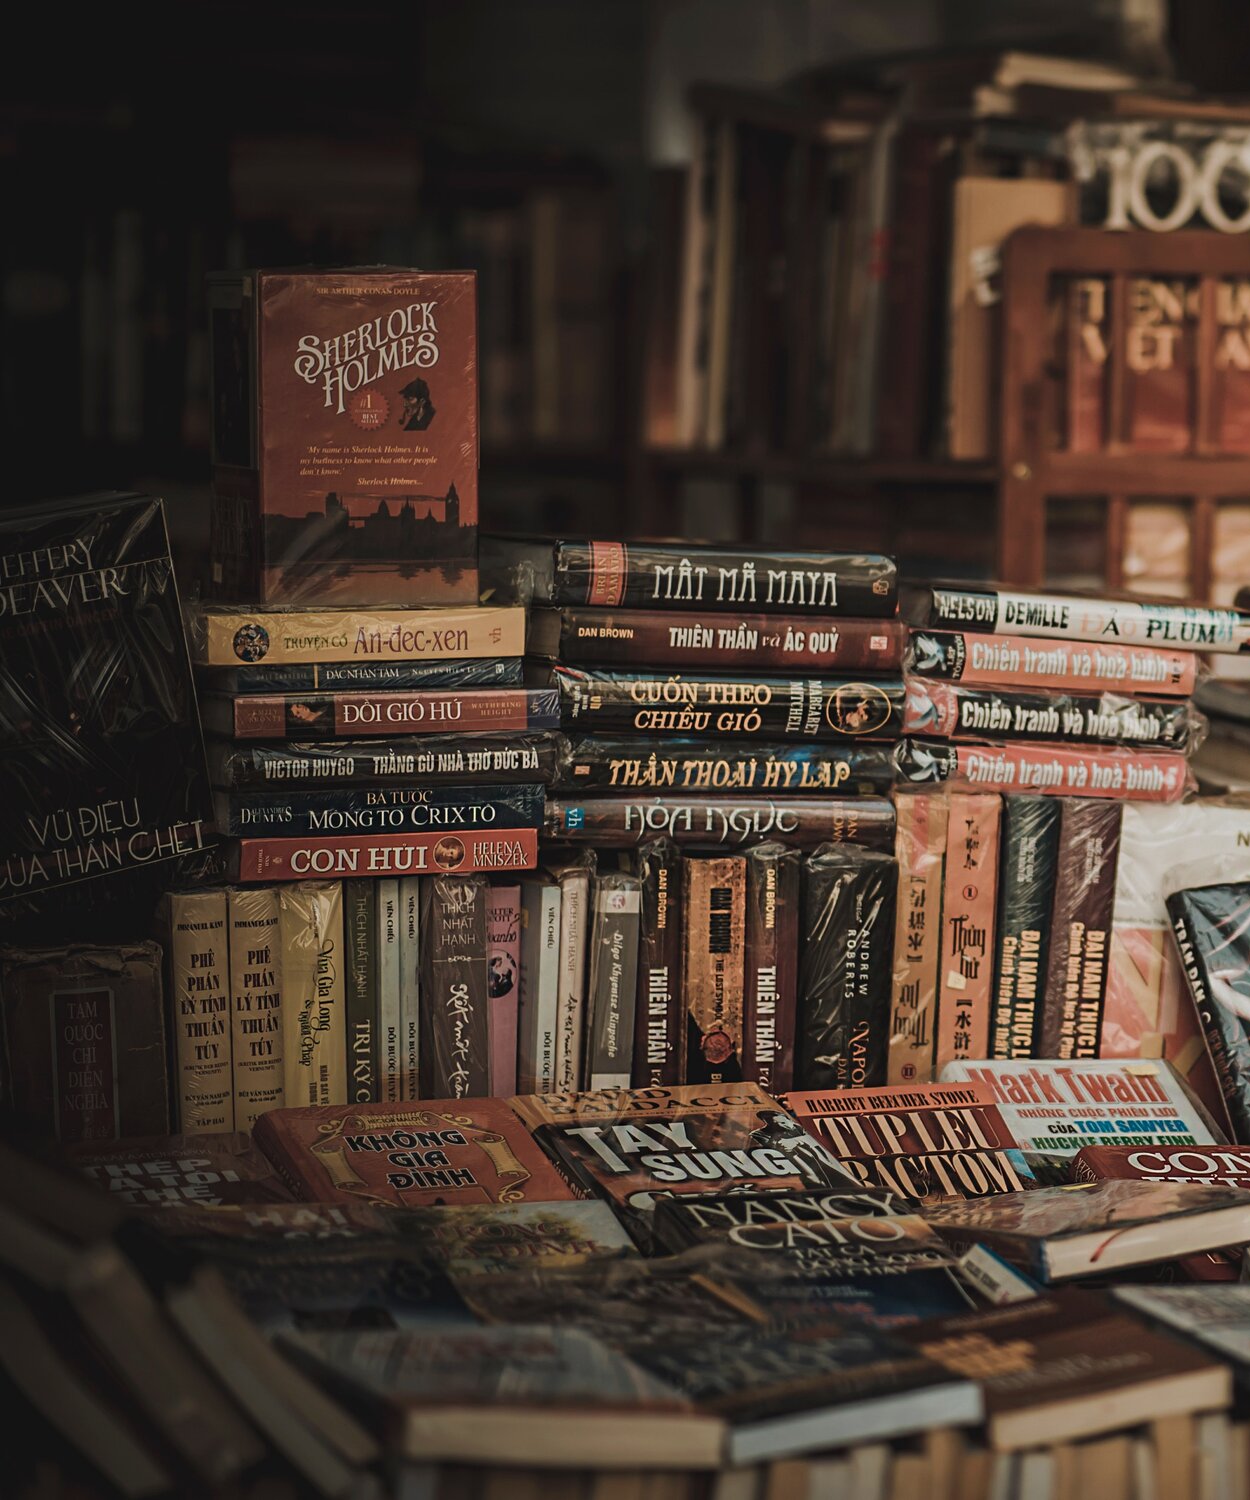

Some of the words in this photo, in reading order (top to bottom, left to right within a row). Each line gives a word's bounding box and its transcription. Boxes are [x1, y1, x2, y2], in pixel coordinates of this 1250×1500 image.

[294, 301, 439, 384] SHERLOCK
[322, 332, 439, 415] HOLMES
[413, 456, 438, 466] people
[765, 569, 838, 607] MAYA
[938, 591, 997, 623] NELSON
[1005, 600, 1070, 630] DEMILLE
[578, 627, 597, 638] DAN
[599, 627, 634, 639] BROWN
[669, 623, 713, 649] THIÊN
[706, 682, 772, 706] THEO
[343, 699, 381, 723] ĐỒI
[386, 699, 425, 722] GIÓ
[717, 711, 763, 732] GIÓ
[264, 760, 309, 779] VICTOR
[312, 757, 355, 777] HUYGO
[290, 847, 361, 874] CON
[367, 843, 428, 871] HỦI
[472, 853, 528, 868] MNISZEK
[473, 840, 523, 855] HELENA
[657, 868, 668, 889] DAN
[765, 868, 776, 889] DAN
[657, 891, 668, 929] BROWN
[765, 891, 776, 929] BROWN
[844, 929, 857, 999] ROBERTS
[859, 929, 872, 996] ANDREW
[965, 1066, 1068, 1106] Mark
[1054, 1066, 1172, 1105] Twain
[805, 1095, 867, 1114] HARRIET
[867, 1092, 930, 1111] BEECHER
[929, 1088, 981, 1107] STOWE
[1076, 1119, 1118, 1133] TOM
[1119, 1119, 1189, 1133] SAWYER
[343, 1129, 469, 1153] KHÔNG
[563, 1121, 698, 1173] TAY
[387, 1150, 452, 1169] GIA
[684, 1191, 906, 1229] NANCY
[726, 1216, 906, 1249] CATO
